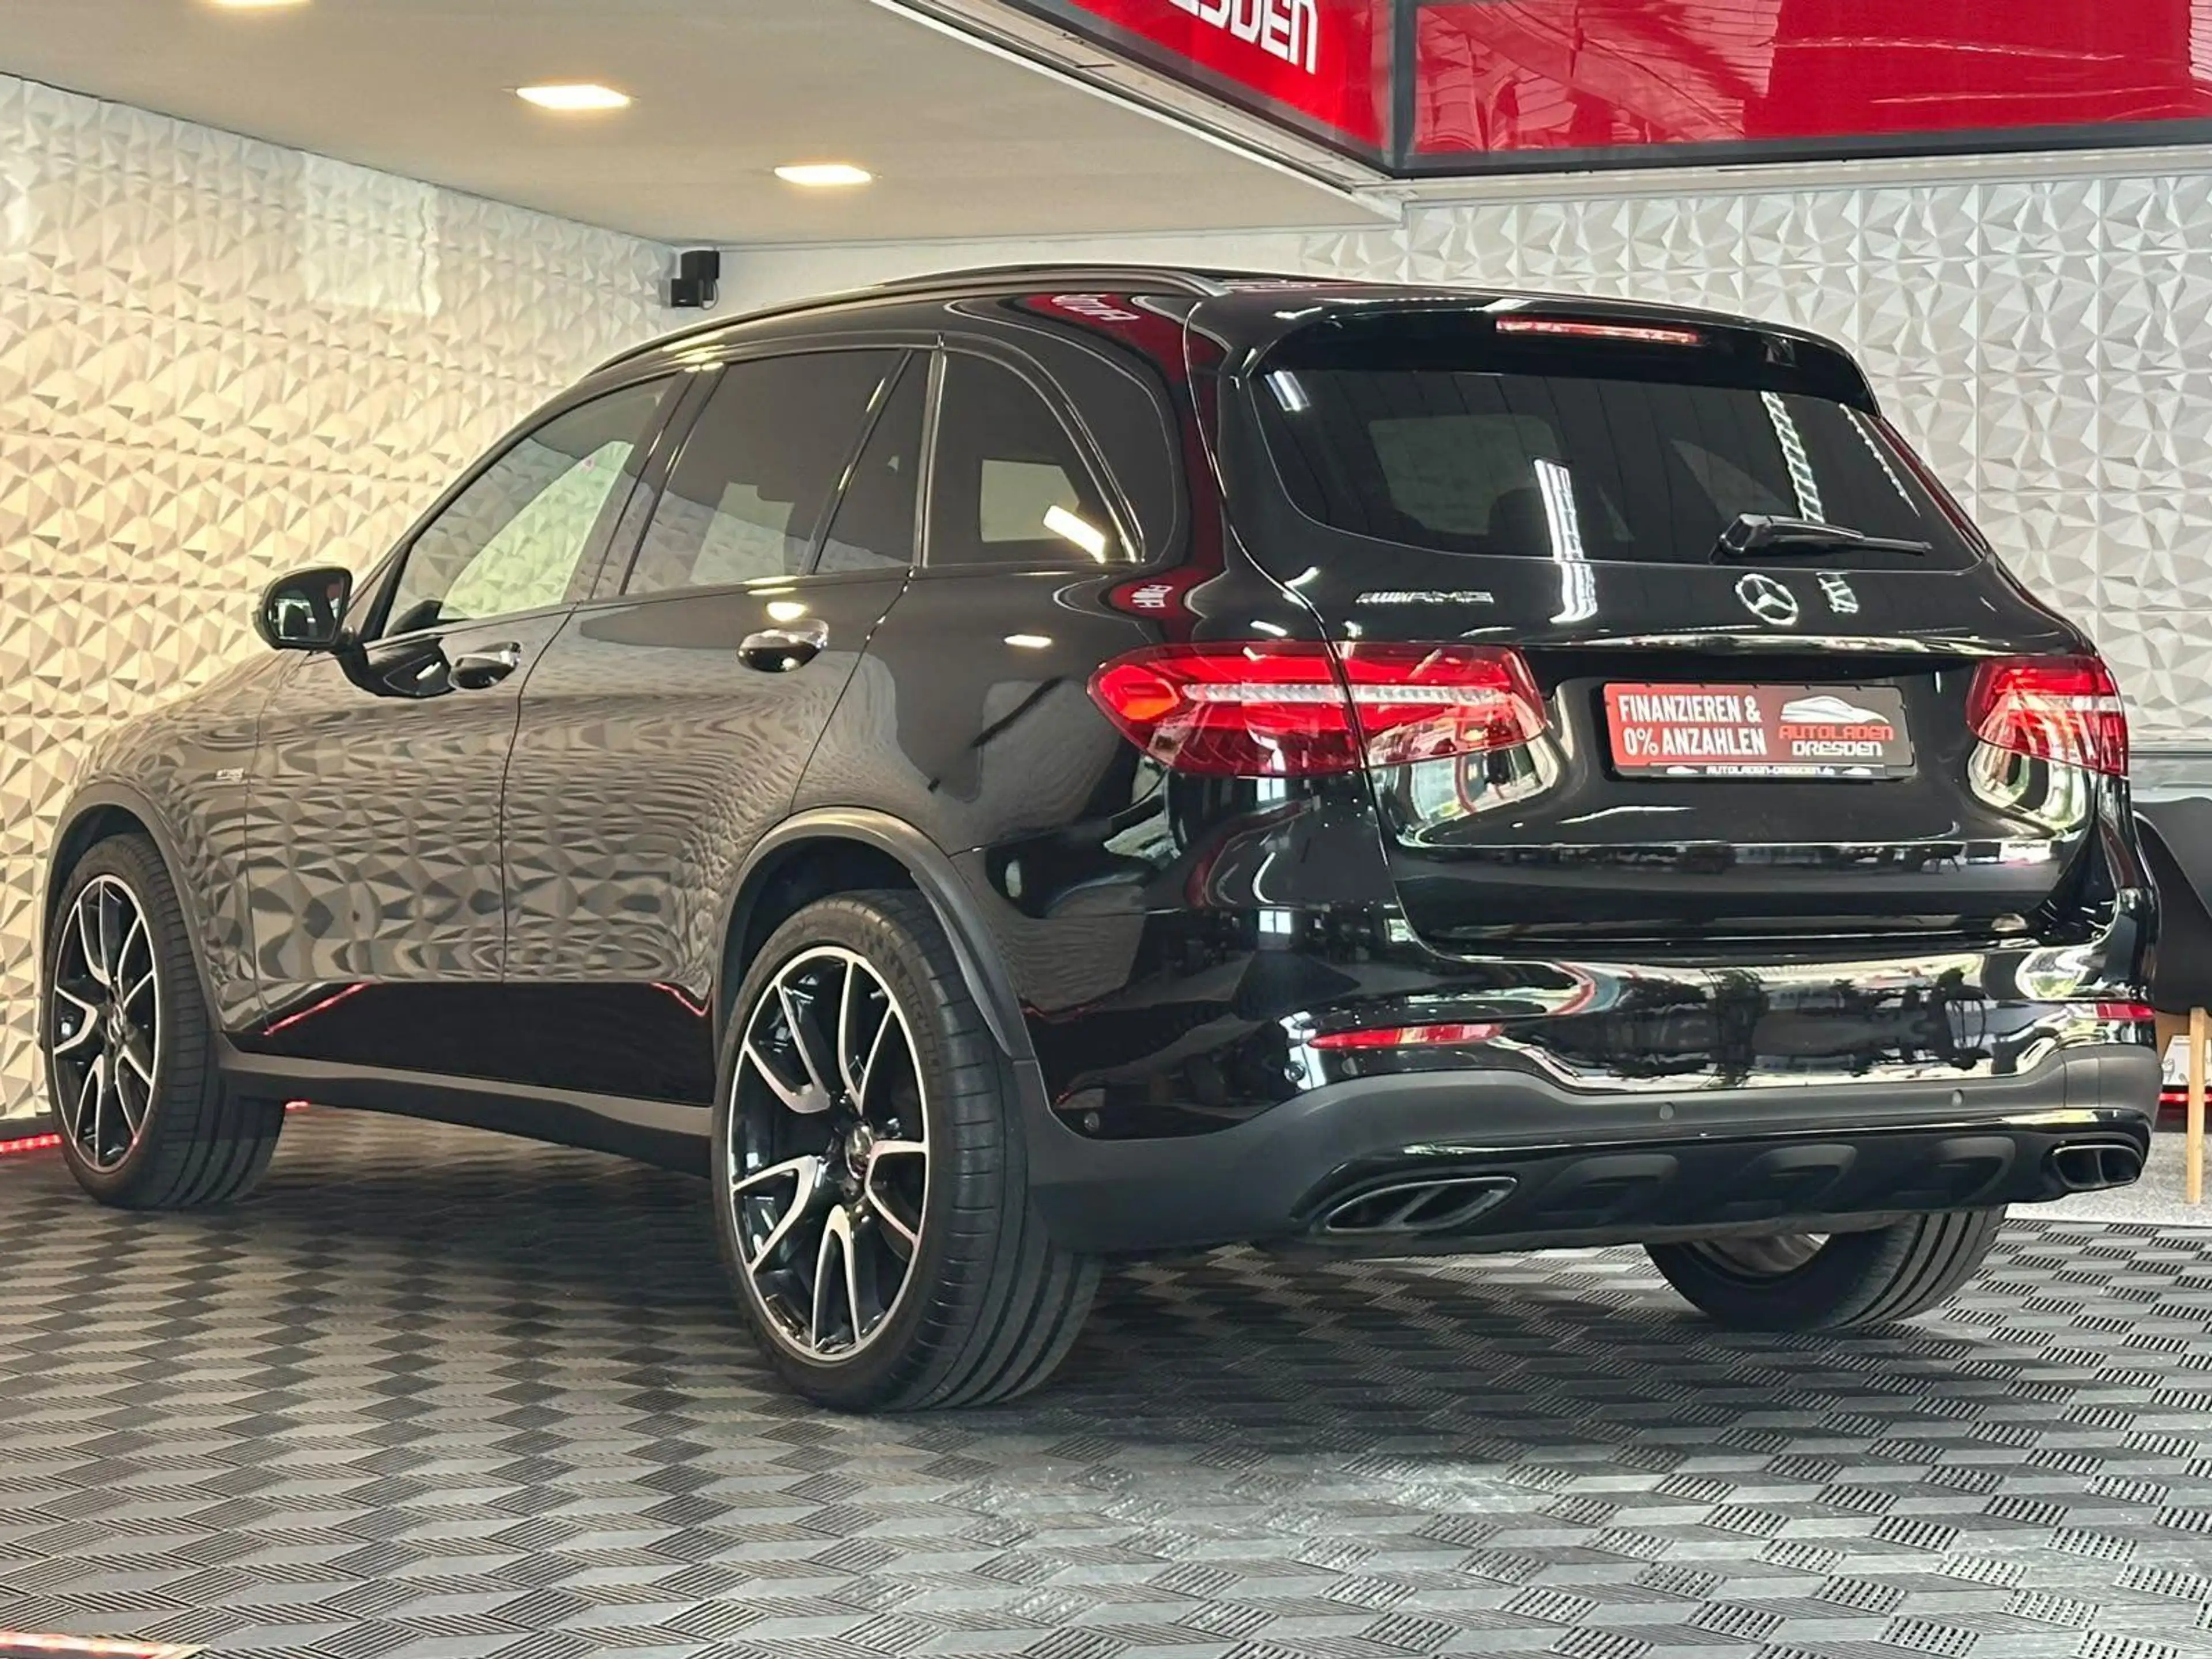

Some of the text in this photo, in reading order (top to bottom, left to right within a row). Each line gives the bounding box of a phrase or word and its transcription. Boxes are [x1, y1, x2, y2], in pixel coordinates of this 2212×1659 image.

[1618, 695, 1763, 723] FINANZIEREN &
[1623, 727, 1768, 756] 0% ANZAHLEN
[1779, 725, 1894, 740] AUTOLADEN
[1792, 740, 1883, 757] DRESDEN
